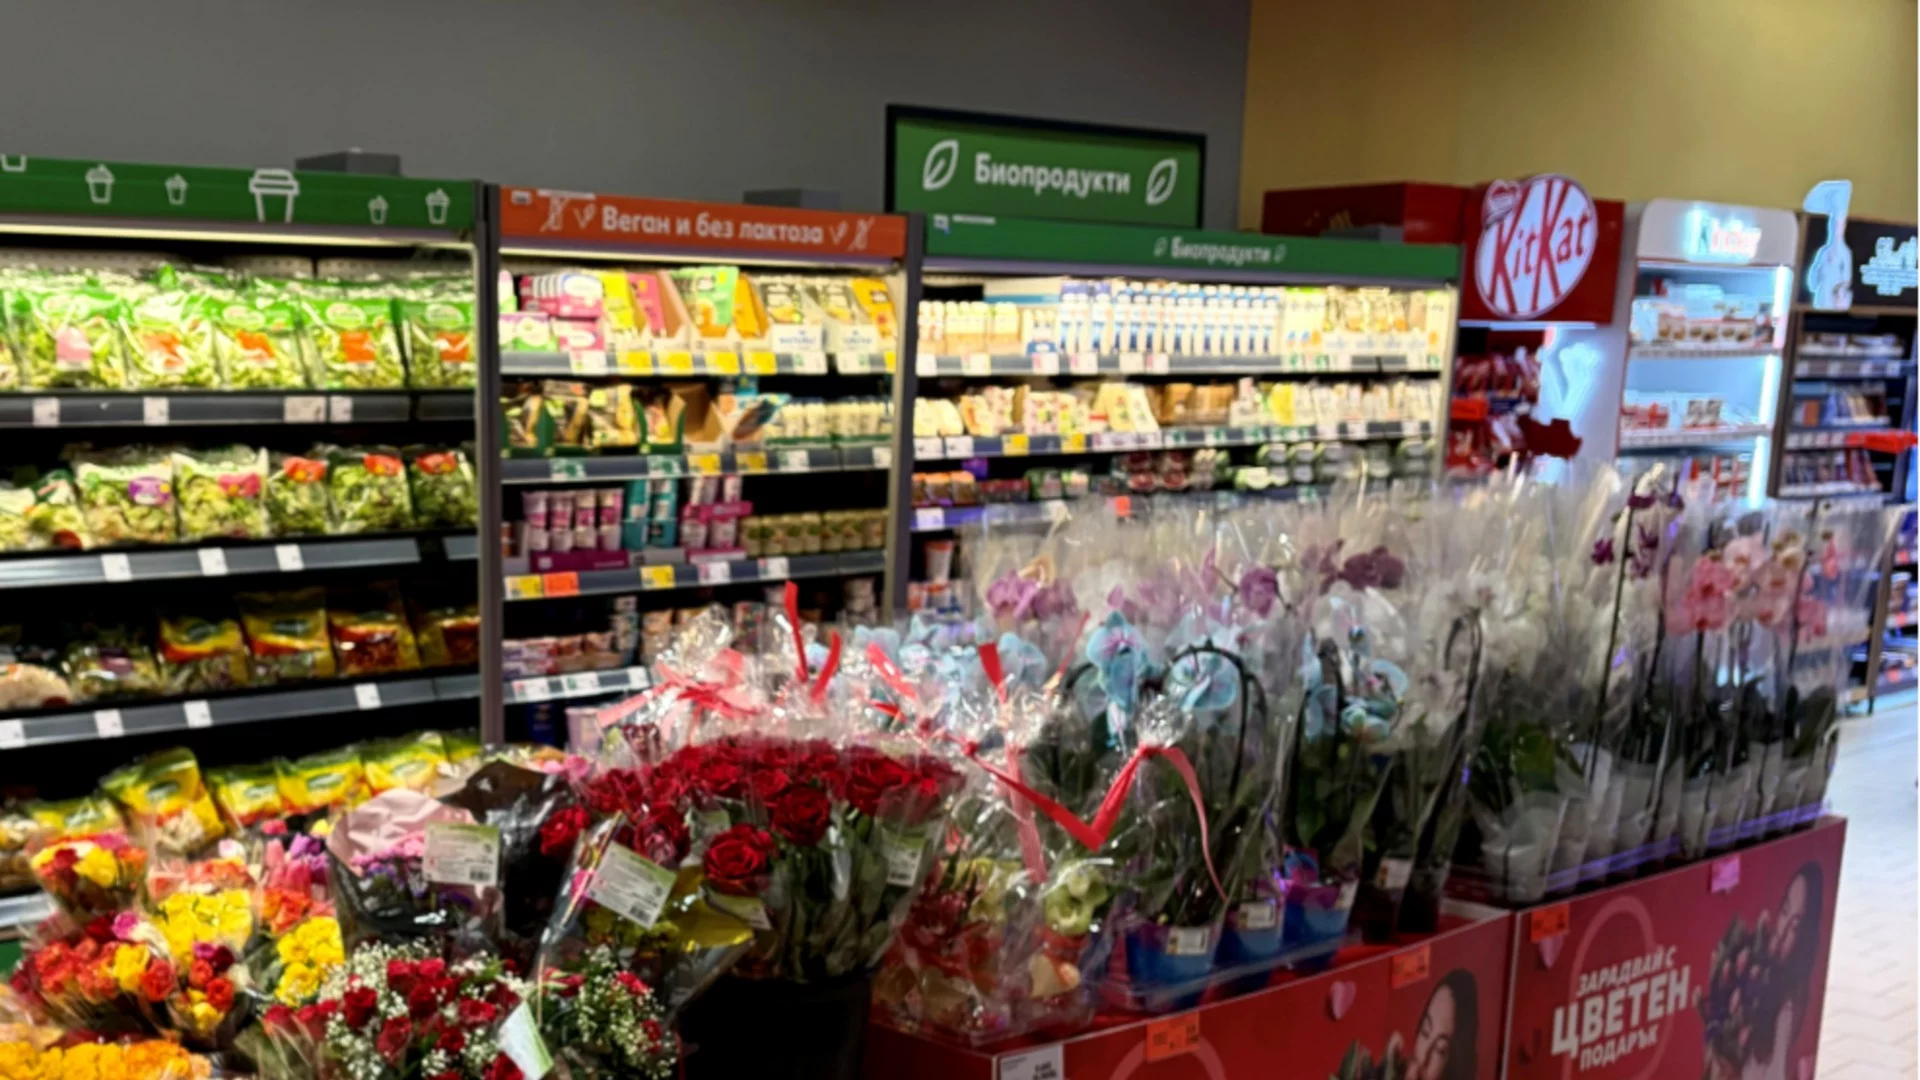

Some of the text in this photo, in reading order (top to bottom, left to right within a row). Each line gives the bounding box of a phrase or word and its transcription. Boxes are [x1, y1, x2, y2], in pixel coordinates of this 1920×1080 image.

[975, 153, 1131, 198] Биопродукти
[602, 205, 824, 244] Веган и без лактоза
[1488, 179, 1591, 314] KitKat
[1171, 236, 1271, 267] Биопродукти
[1576, 944, 1664, 997] ЗАРАДВАЙ
[1551, 965, 1690, 1059] ЦВЕТЕН
[1579, 1024, 1659, 1072] ПОДАРЪК
